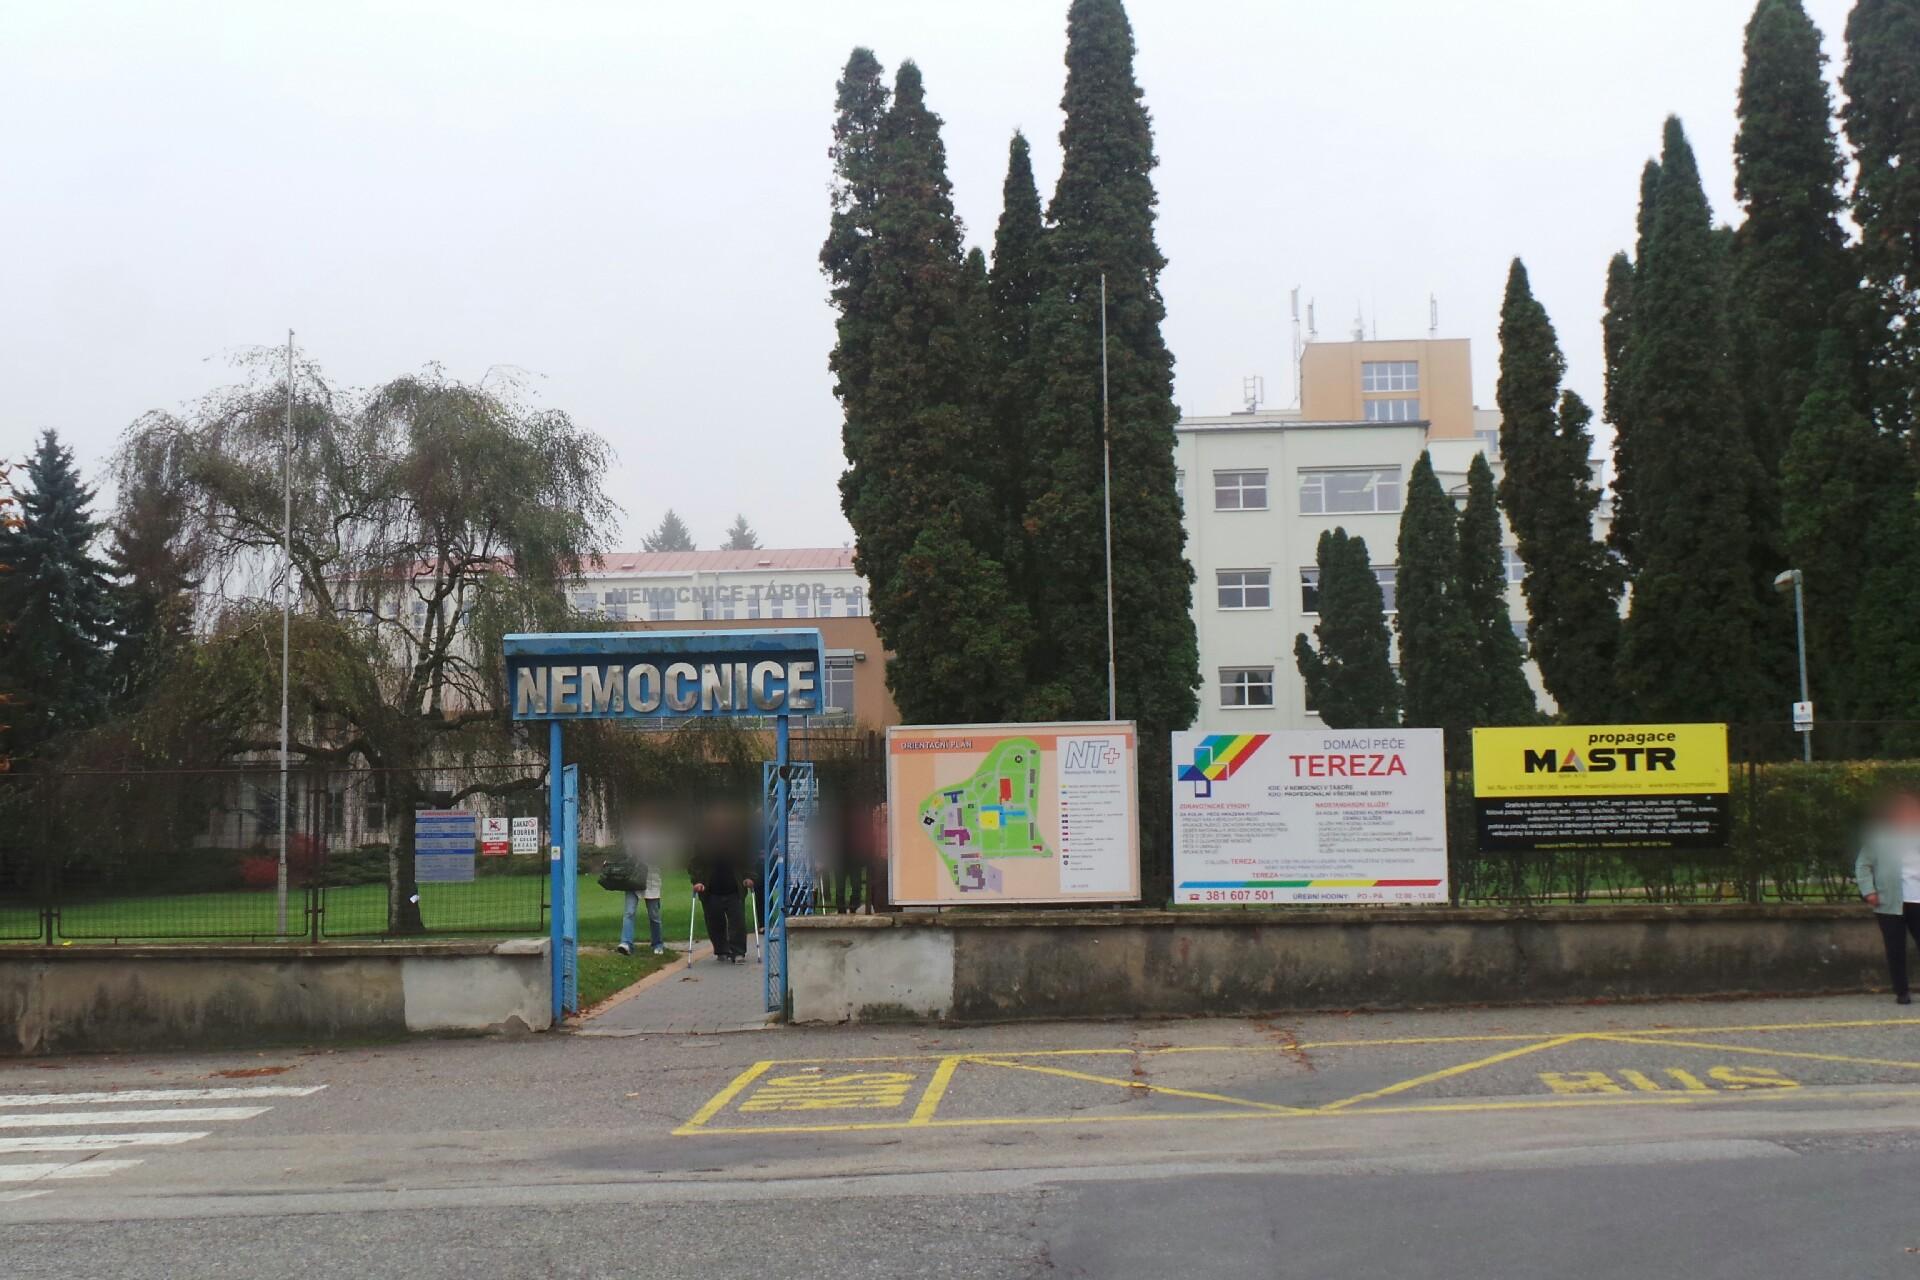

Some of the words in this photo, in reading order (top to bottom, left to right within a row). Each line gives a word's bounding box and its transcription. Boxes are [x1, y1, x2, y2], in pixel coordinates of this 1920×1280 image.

[613, 584, 744, 604] NEMOCNICE
[751, 579, 825, 601] TÁBOR
[517, 660, 816, 714] NEMOCNICE
[1323, 738, 1370, 750] DOMÁCÍ
[1588, 733, 1676, 745] propagace
[1289, 754, 1407, 777] TEREZA
[1524, 747, 1676, 773] MASTR
[1206, 890, 1225, 900] 381
[1230, 890, 1250, 900] 607
[1255, 890, 1274, 900] 501
